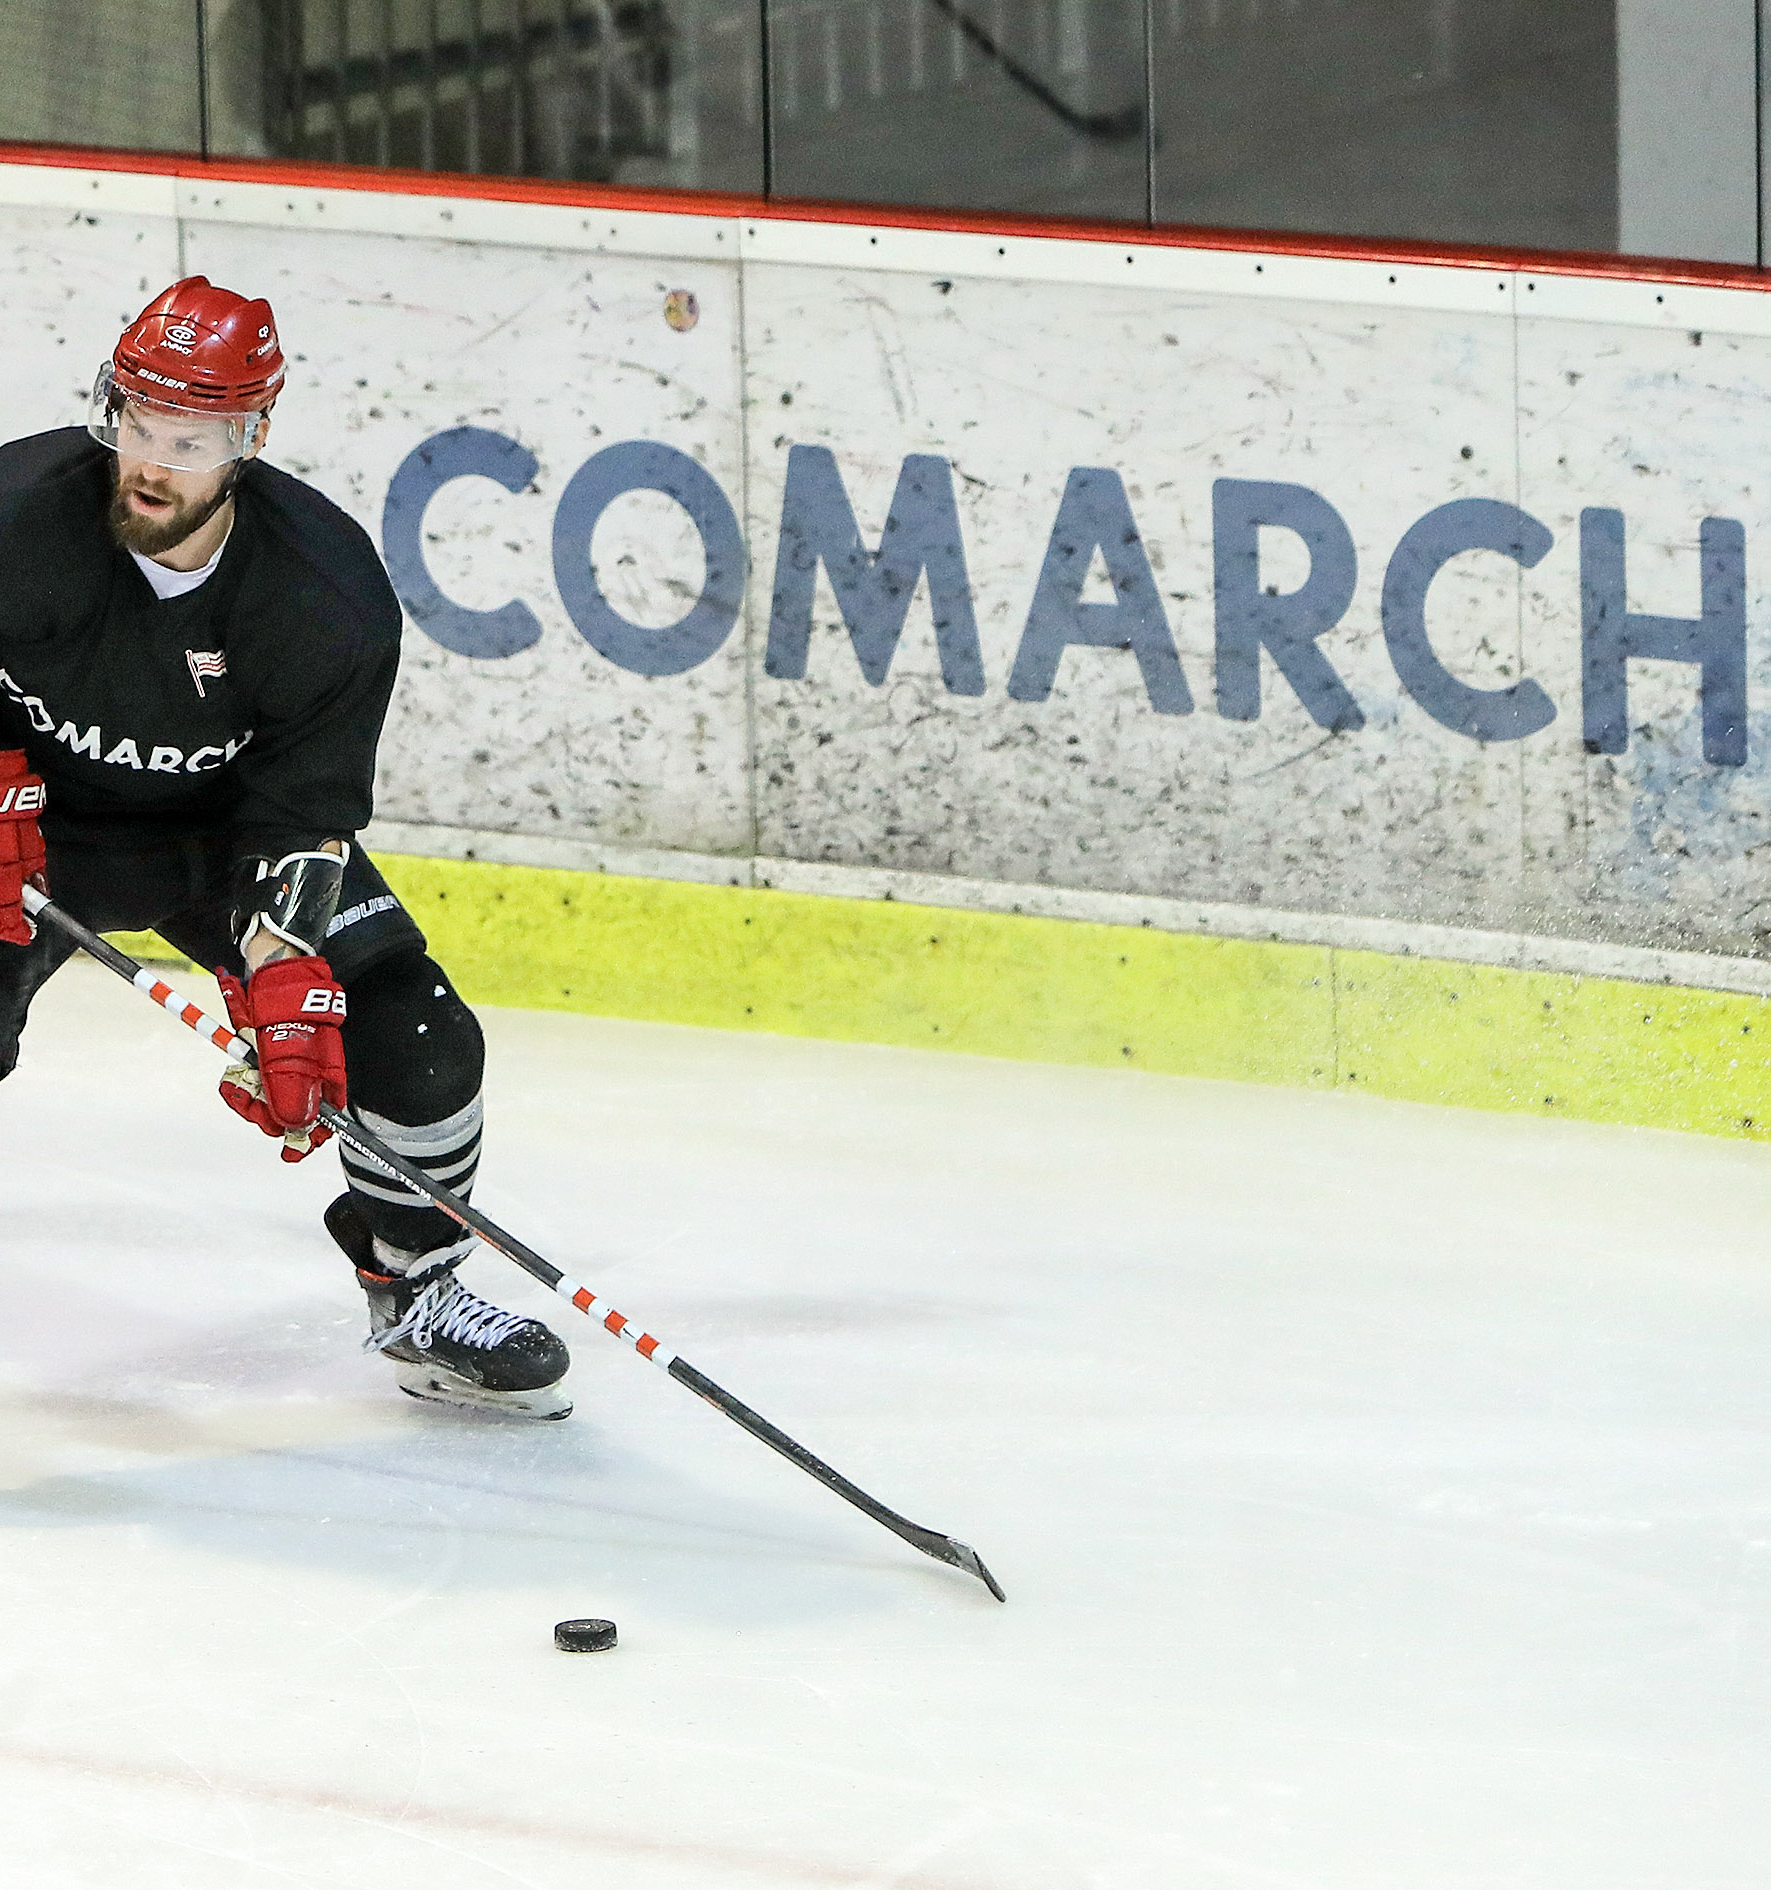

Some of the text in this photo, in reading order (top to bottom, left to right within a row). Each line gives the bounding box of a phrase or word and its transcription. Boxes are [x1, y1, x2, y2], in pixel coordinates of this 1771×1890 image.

[382, 426, 1748, 769] COMARCH
[265, 1022, 317, 1034] NEXUS
[338, 1129, 397, 1177] CRACOVIA
[399, 1172, 432, 1201] TEAM
